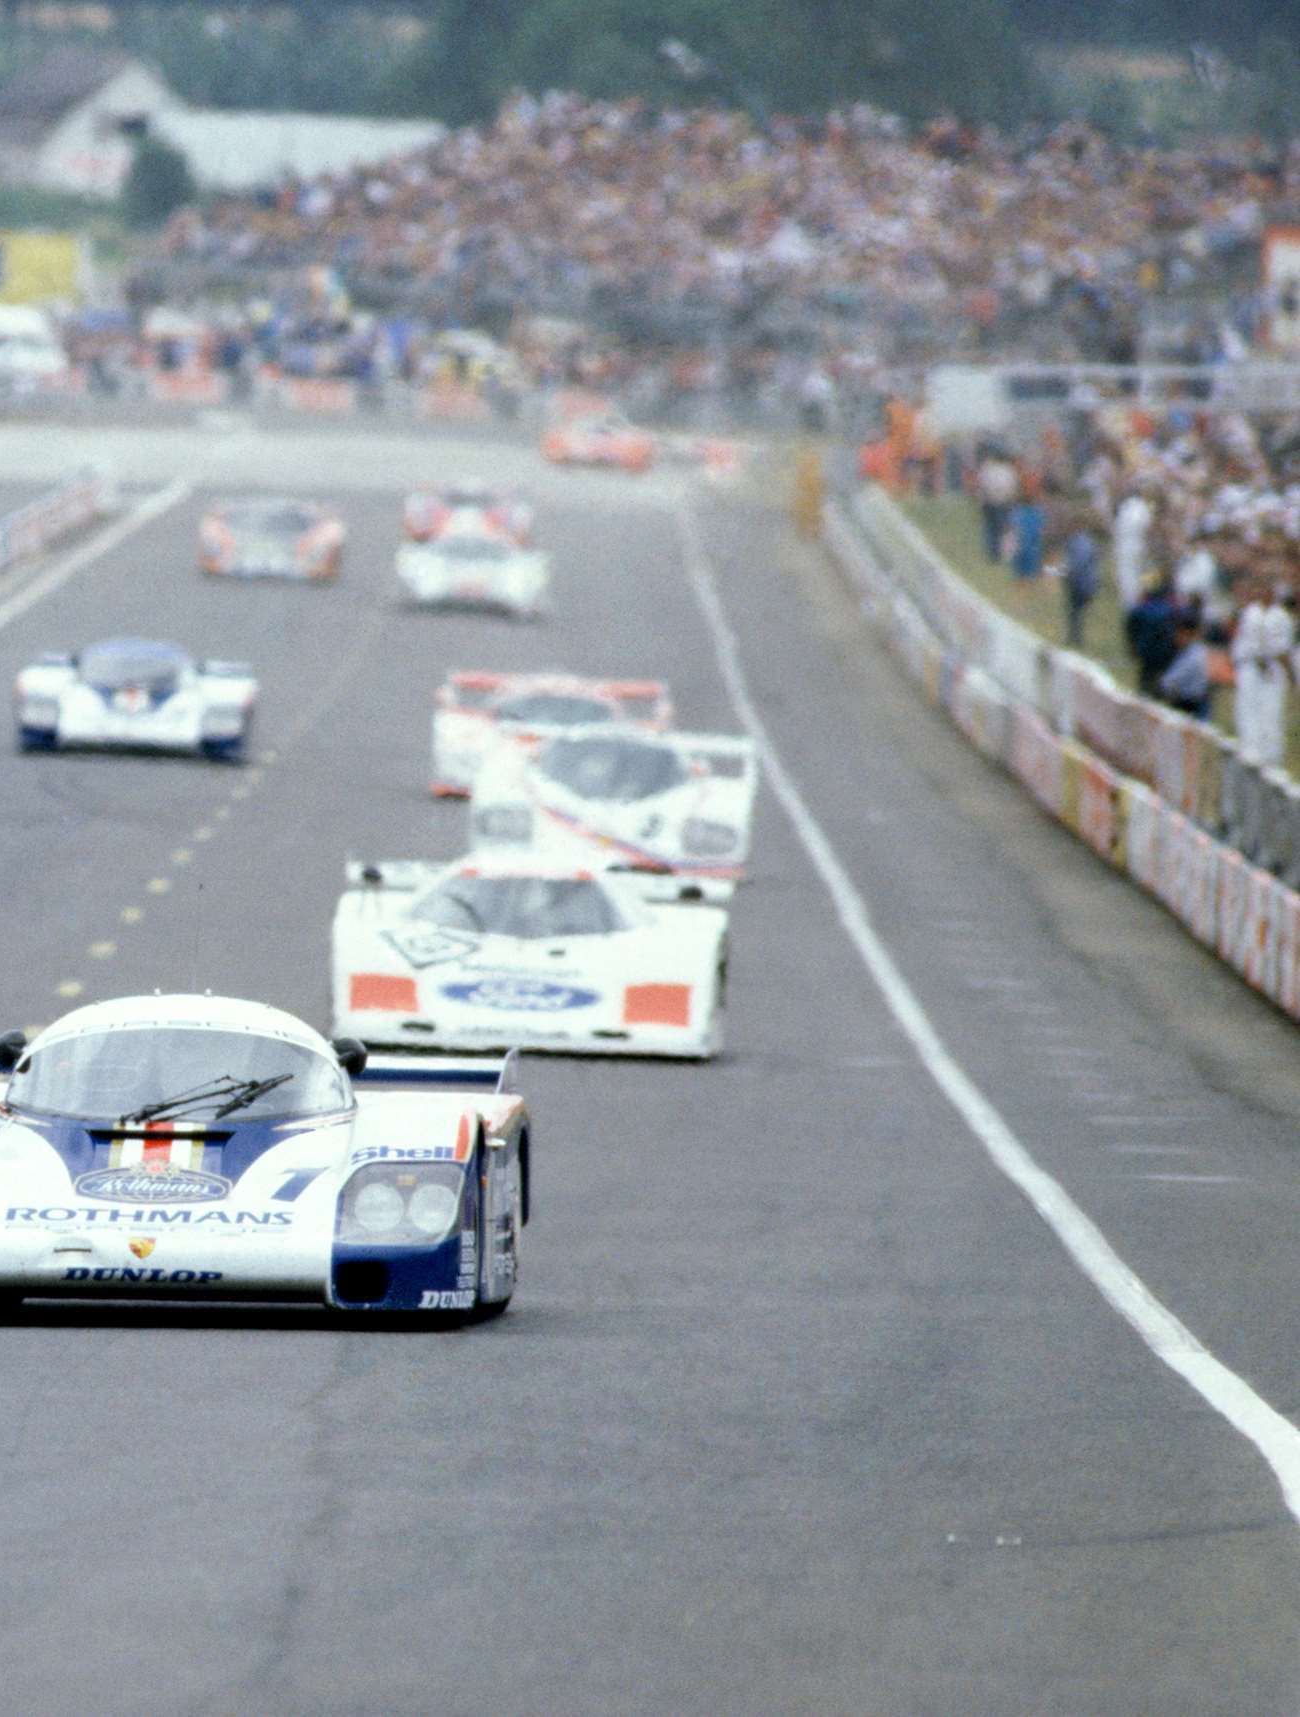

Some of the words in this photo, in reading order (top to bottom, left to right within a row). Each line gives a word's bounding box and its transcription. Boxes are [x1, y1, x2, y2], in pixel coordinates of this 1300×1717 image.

[351, 1146, 454, 1166] Shell
[269, 1166, 330, 1202] 1
[5, 1207, 293, 1225] ROTHMANS
[61, 1267, 224, 1283] DUNLOP
